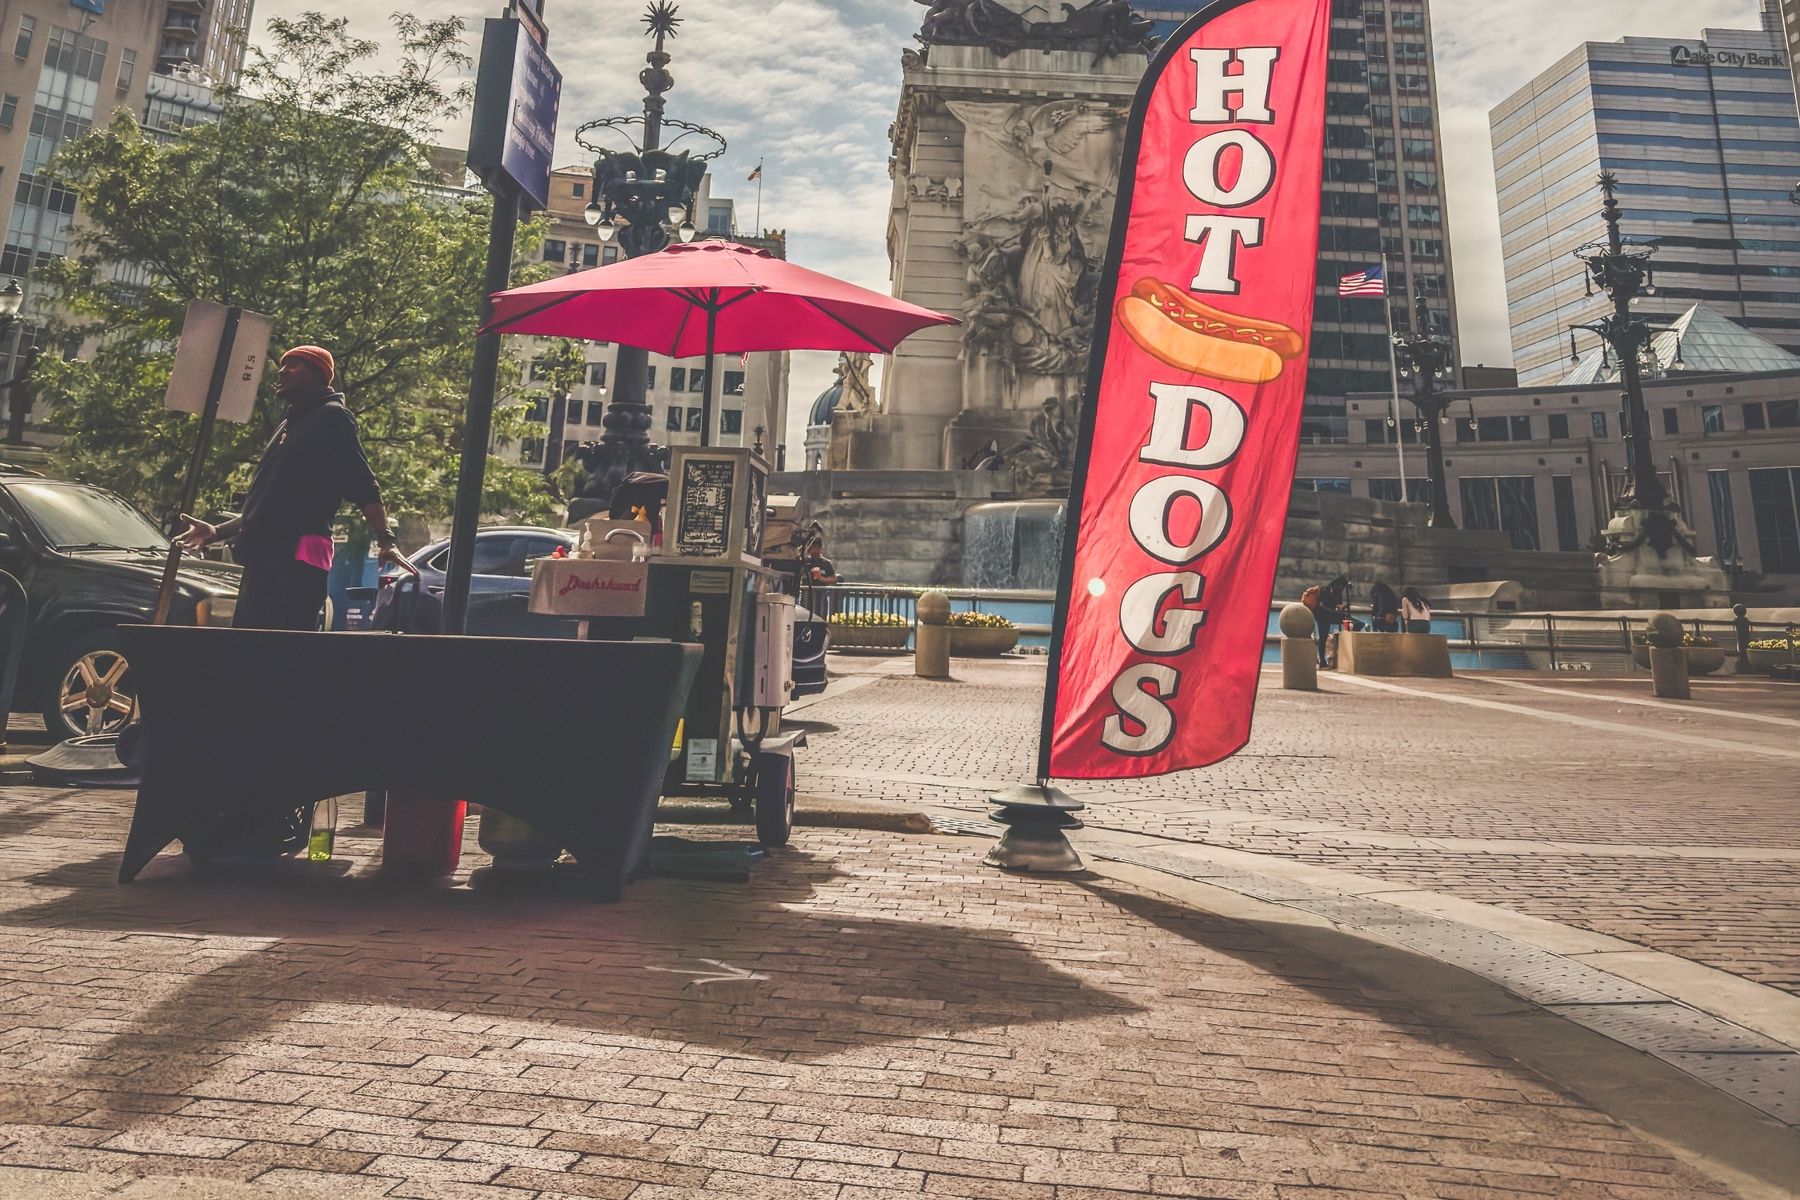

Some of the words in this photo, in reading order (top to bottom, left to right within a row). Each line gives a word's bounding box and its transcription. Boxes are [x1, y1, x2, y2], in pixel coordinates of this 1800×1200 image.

[1183, 46, 1281, 295] HOT
[1717, 51, 1745, 67] City
[1748, 52, 1784, 66] Bank
[1101, 381, 1248, 756] DOGS
